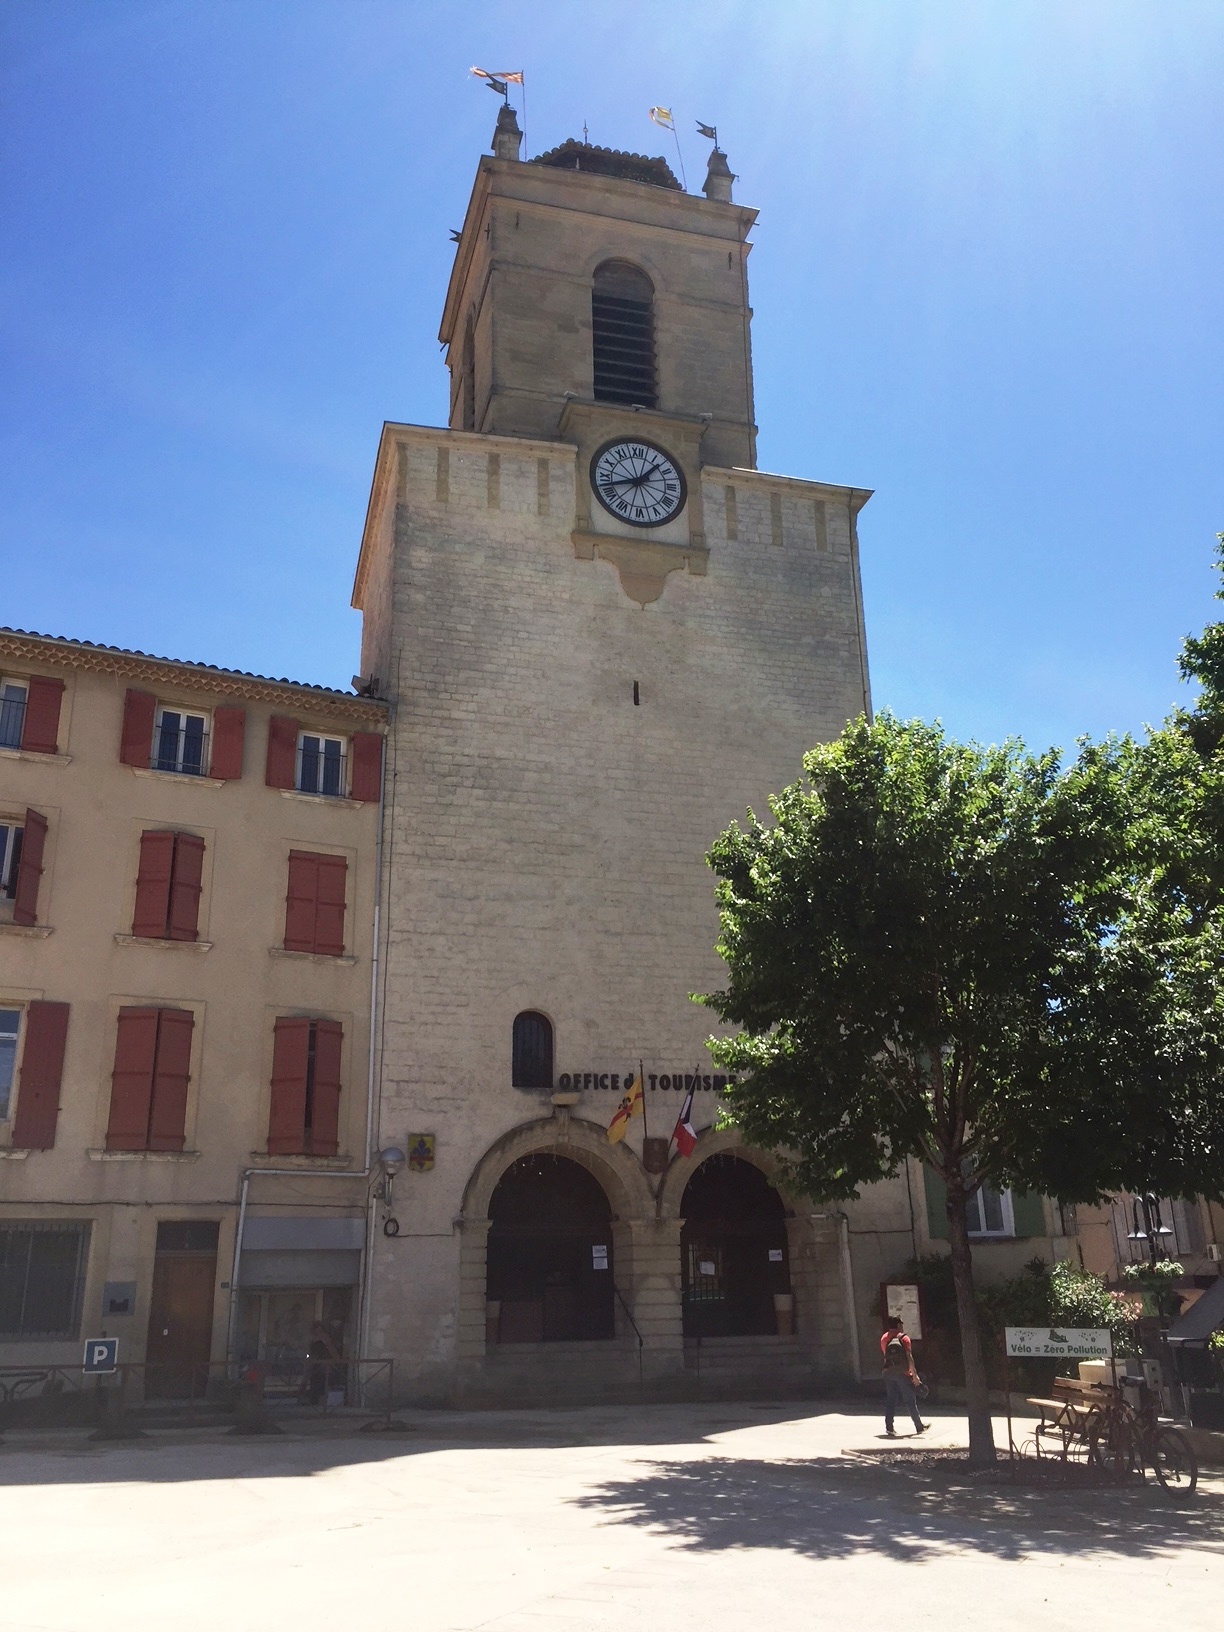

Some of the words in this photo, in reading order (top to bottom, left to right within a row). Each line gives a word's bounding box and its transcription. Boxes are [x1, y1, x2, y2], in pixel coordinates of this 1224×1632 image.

[615, 448, 627, 459] XI
[632, 447, 644, 458] XII
[604, 458, 615, 468] X
[600, 472, 610, 482] IX
[666, 483, 677, 492] III
[616, 500, 628, 513] VII
[653, 507, 661, 517] V
[635, 508, 645, 519] VI
[559, 1073, 619, 1091] OFFICE
[1011, 1344, 1032, 1353] Vélo
[1044, 1344, 1065, 1354] Zéro
[1067, 1345, 1108, 1354] Pollution
[93, 1345, 108, 1365] P
